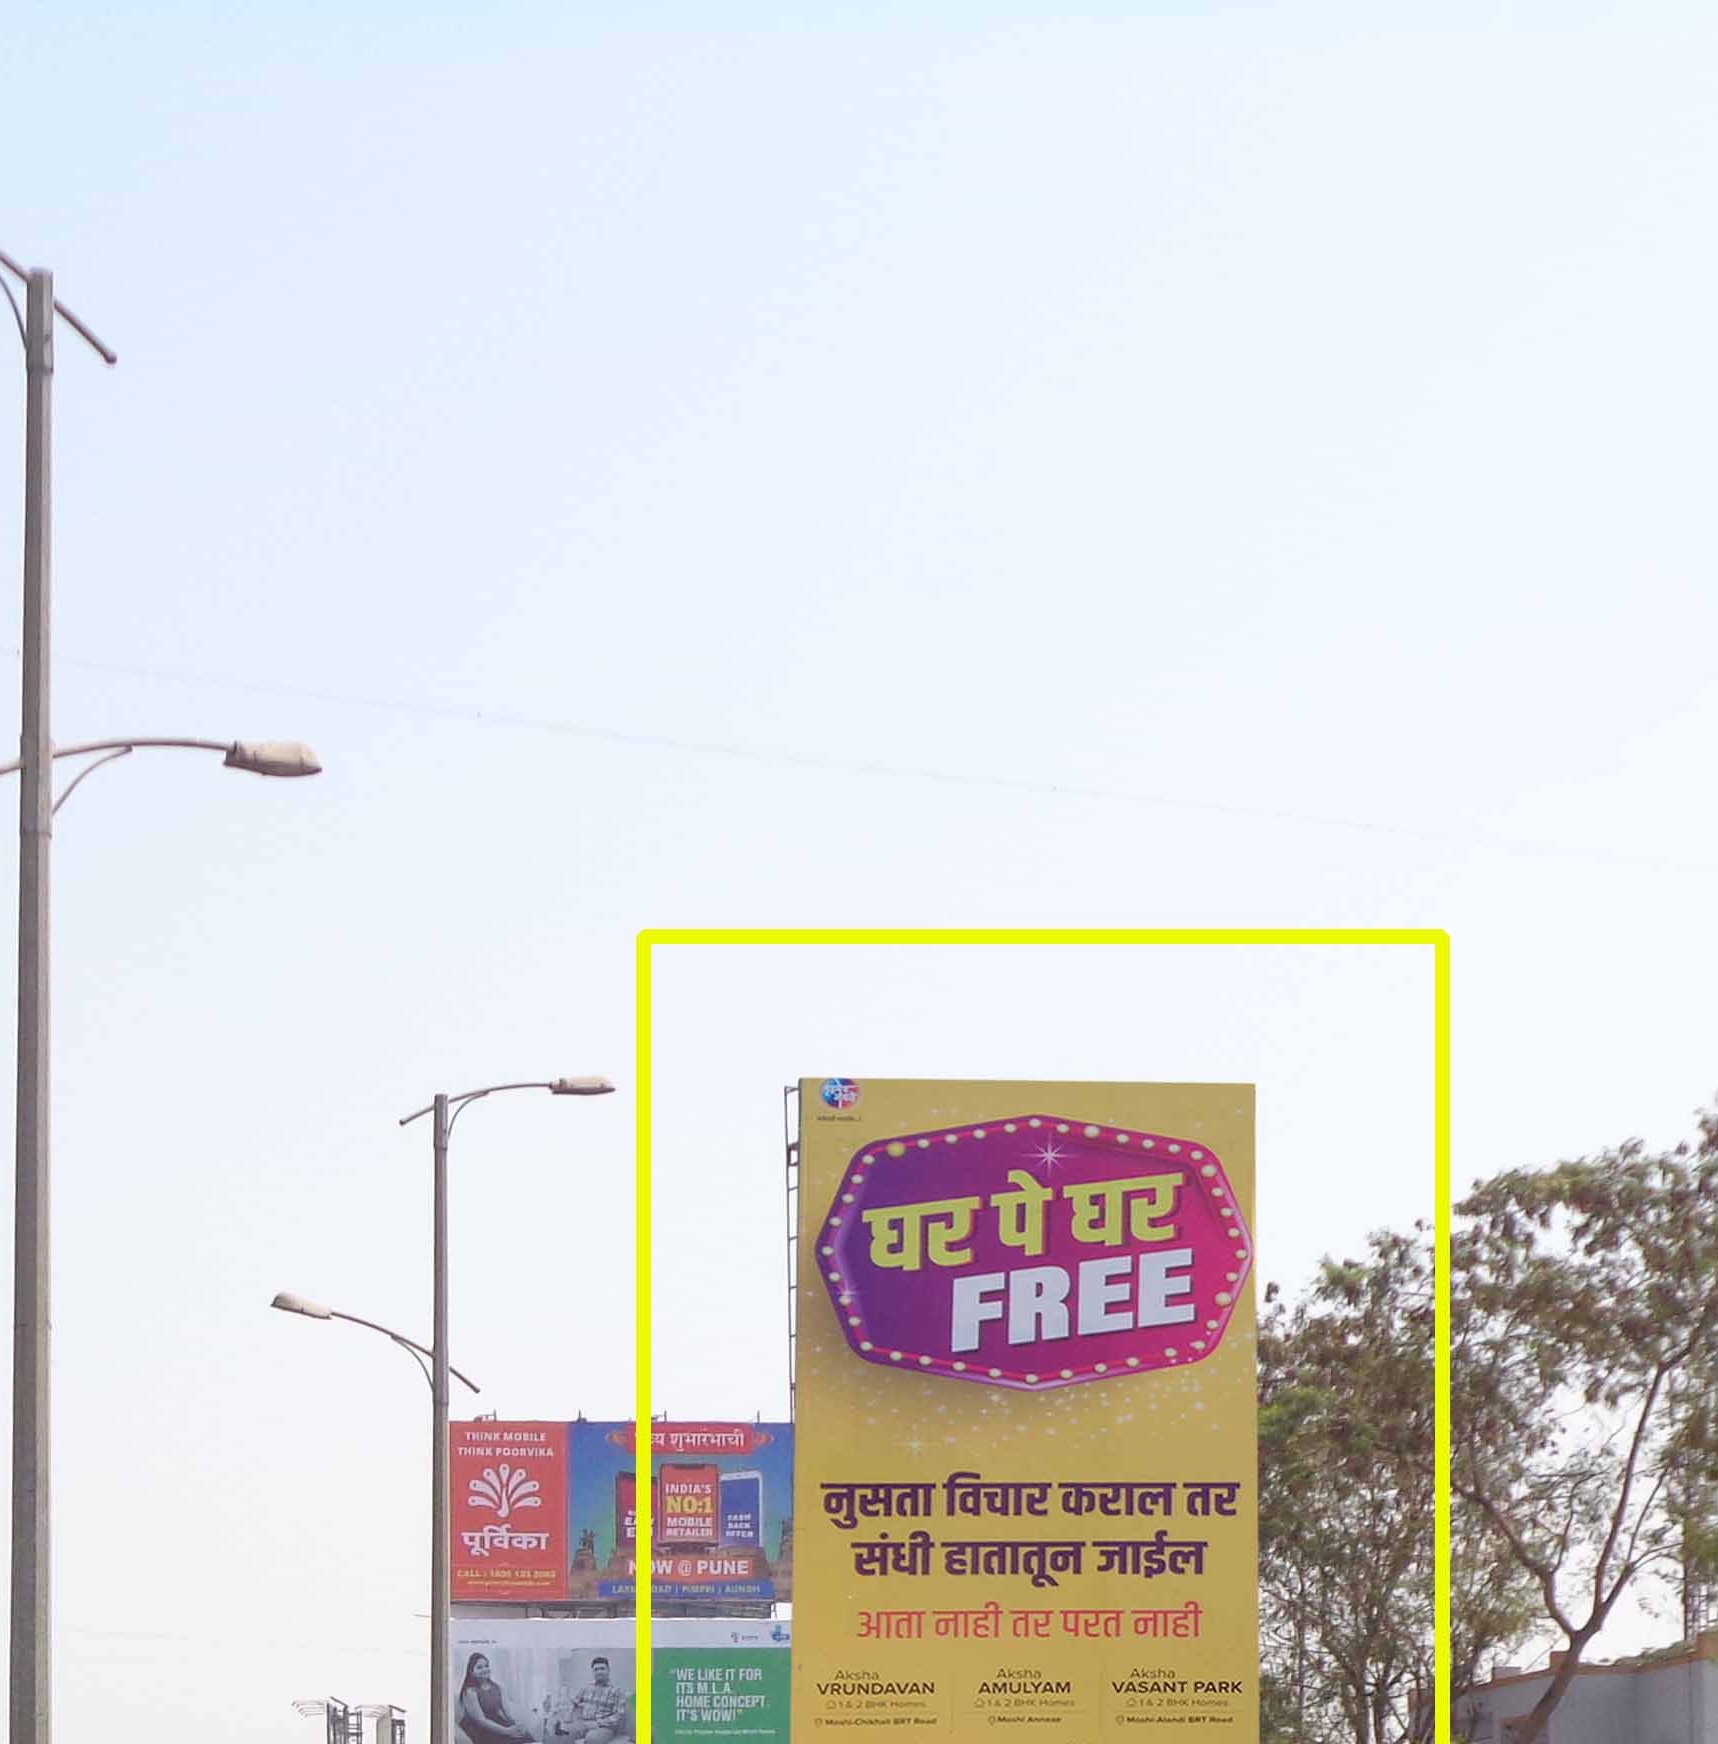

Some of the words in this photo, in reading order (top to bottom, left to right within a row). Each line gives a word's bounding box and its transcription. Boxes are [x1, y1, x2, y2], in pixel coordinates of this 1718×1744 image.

[863, 1197, 980, 1270] घर
[991, 1169, 1052, 1257] पे
[1064, 1172, 1183, 1246] घर
[951, 1248, 1196, 1353] FREE
[465, 1431, 500, 1441] THINK
[503, 1431, 547, 1441] MOBILE
[458, 1447, 493, 1457] THINK
[665, 1483, 712, 1494] INDIA'S
[820, 1482, 936, 1529] नुसता
[943, 1472, 1052, 1517] विचार
[1059, 1482, 1177, 1516] कराल
[1184, 1482, 1241, 1516] तर
[666, 1517, 713, 1527] MOBILE
[666, 1528, 713, 1537] RETAILER
[851, 1531, 934, 1575] संधी
[941, 1541, 1085, 1587] हातातून
[1093, 1530, 1208, 1578] जाईल
[697, 1559, 749, 1575] PUNE
[857, 1610, 925, 1638] आता
[933, 1601, 1002, 1639] नाही
[1010, 1610, 1053, 1638] तर
[1060, 1610, 1123, 1638] परत
[1131, 1601, 1202, 1638] नाही
[698, 1668, 723, 1681] LIKE
[725, 1668, 736, 1681] IT
[739, 1667, 763, 1681] FOR
[834, 1670, 880, 1681] Aksha
[996, 1668, 1043, 1679] Aksha
[1130, 1668, 1176, 1679] Aksha
[817, 1682, 935, 1695] VRUNDAVAN
[978, 1682, 1071, 1694] AMULYAM
[1112, 1681, 1188, 1693] VASANT
[1194, 1681, 1243, 1693] PARK
[676, 1695, 711, 1708] HOME
